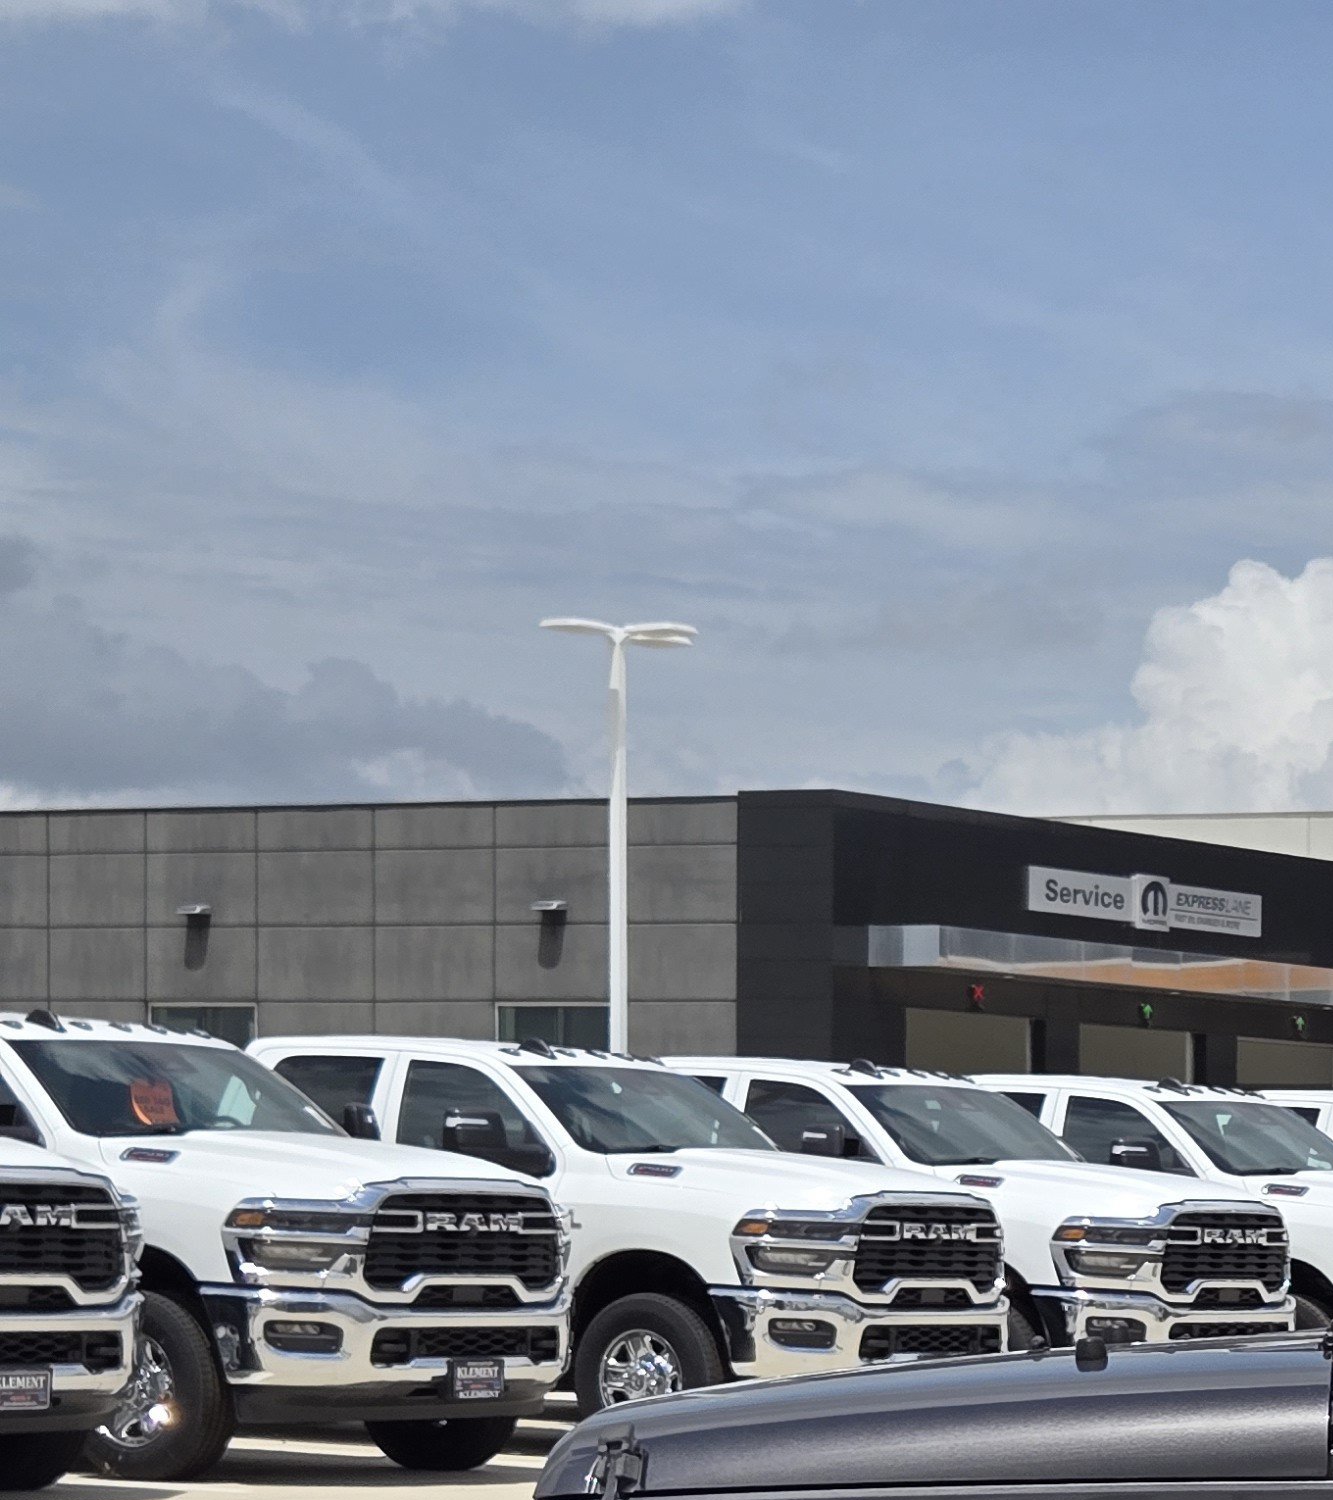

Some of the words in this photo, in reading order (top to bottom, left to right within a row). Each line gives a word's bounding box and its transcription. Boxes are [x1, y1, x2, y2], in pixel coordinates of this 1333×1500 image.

[1045, 878, 1125, 911] Service
[0, 1203, 72, 1226] AM
[426, 1212, 523, 1232] RAM
[903, 1222, 976, 1240] RAM
[1203, 1228, 1267, 1244] RAM
[457, 1366, 499, 1379] KLEMENT
